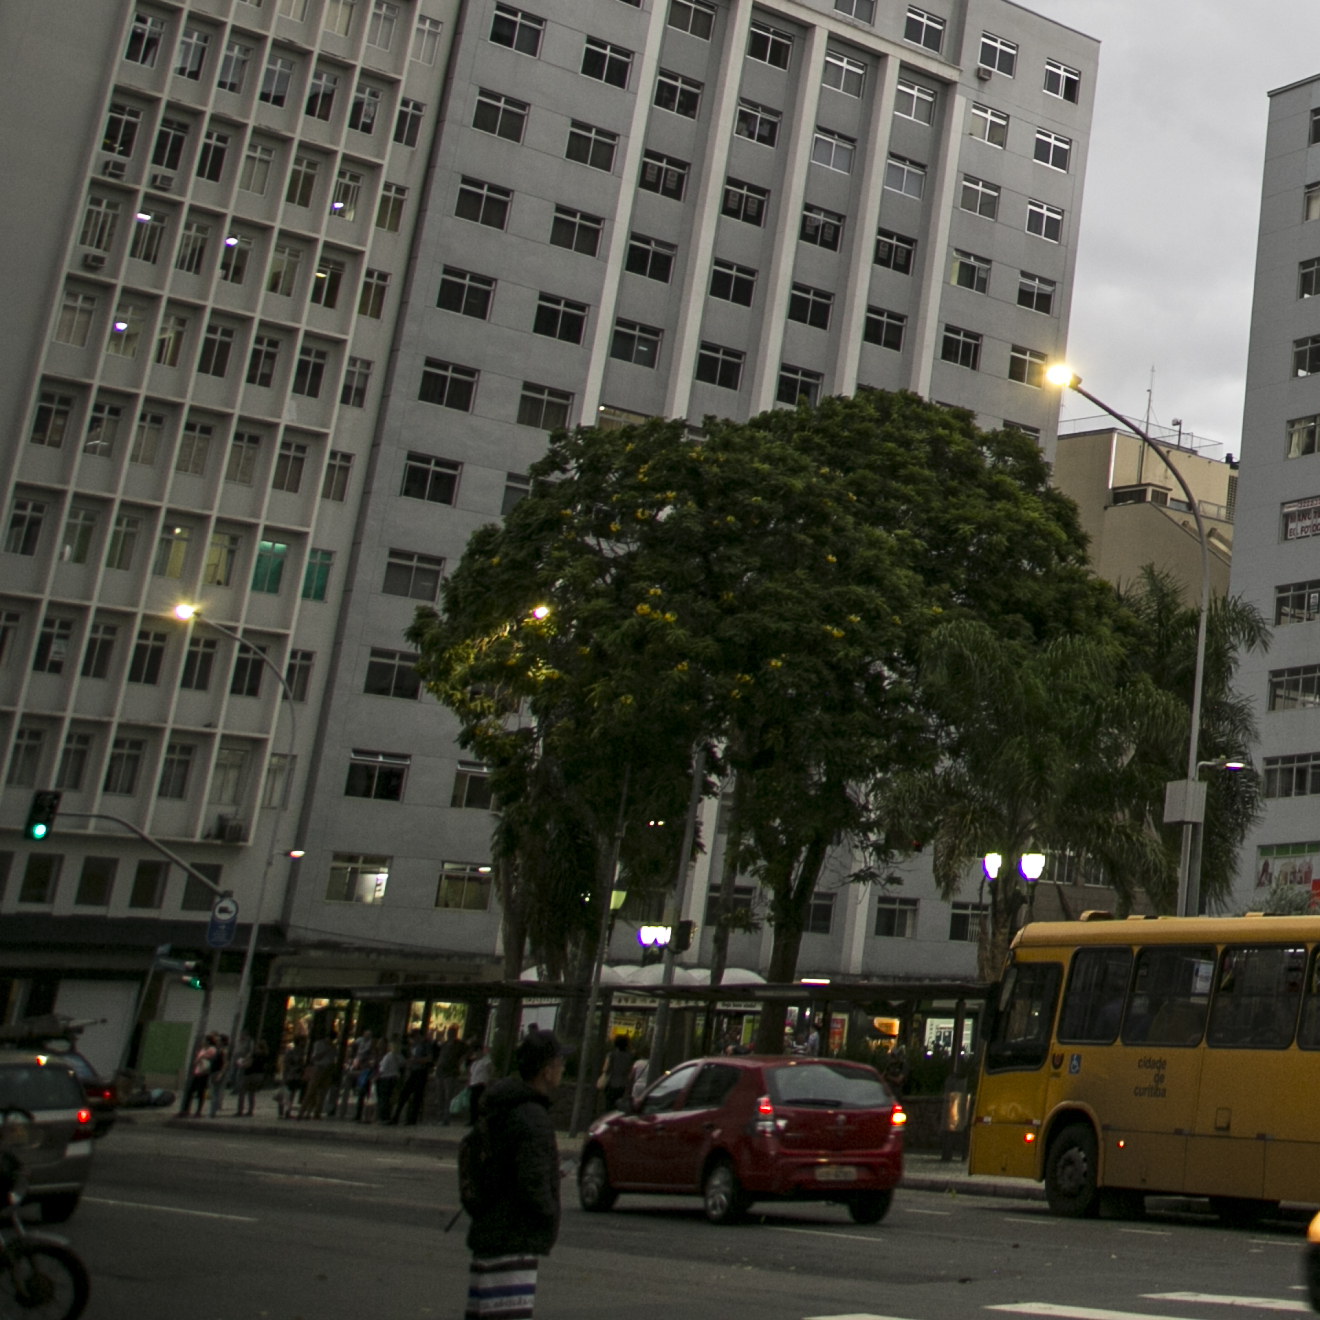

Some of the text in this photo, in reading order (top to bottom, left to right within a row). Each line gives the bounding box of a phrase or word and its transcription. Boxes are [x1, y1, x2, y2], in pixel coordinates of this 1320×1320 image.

[1138, 1056, 1167, 1070] cidade
[1153, 1071, 1166, 1084] de
[1133, 1084, 1167, 1098] curitiba
